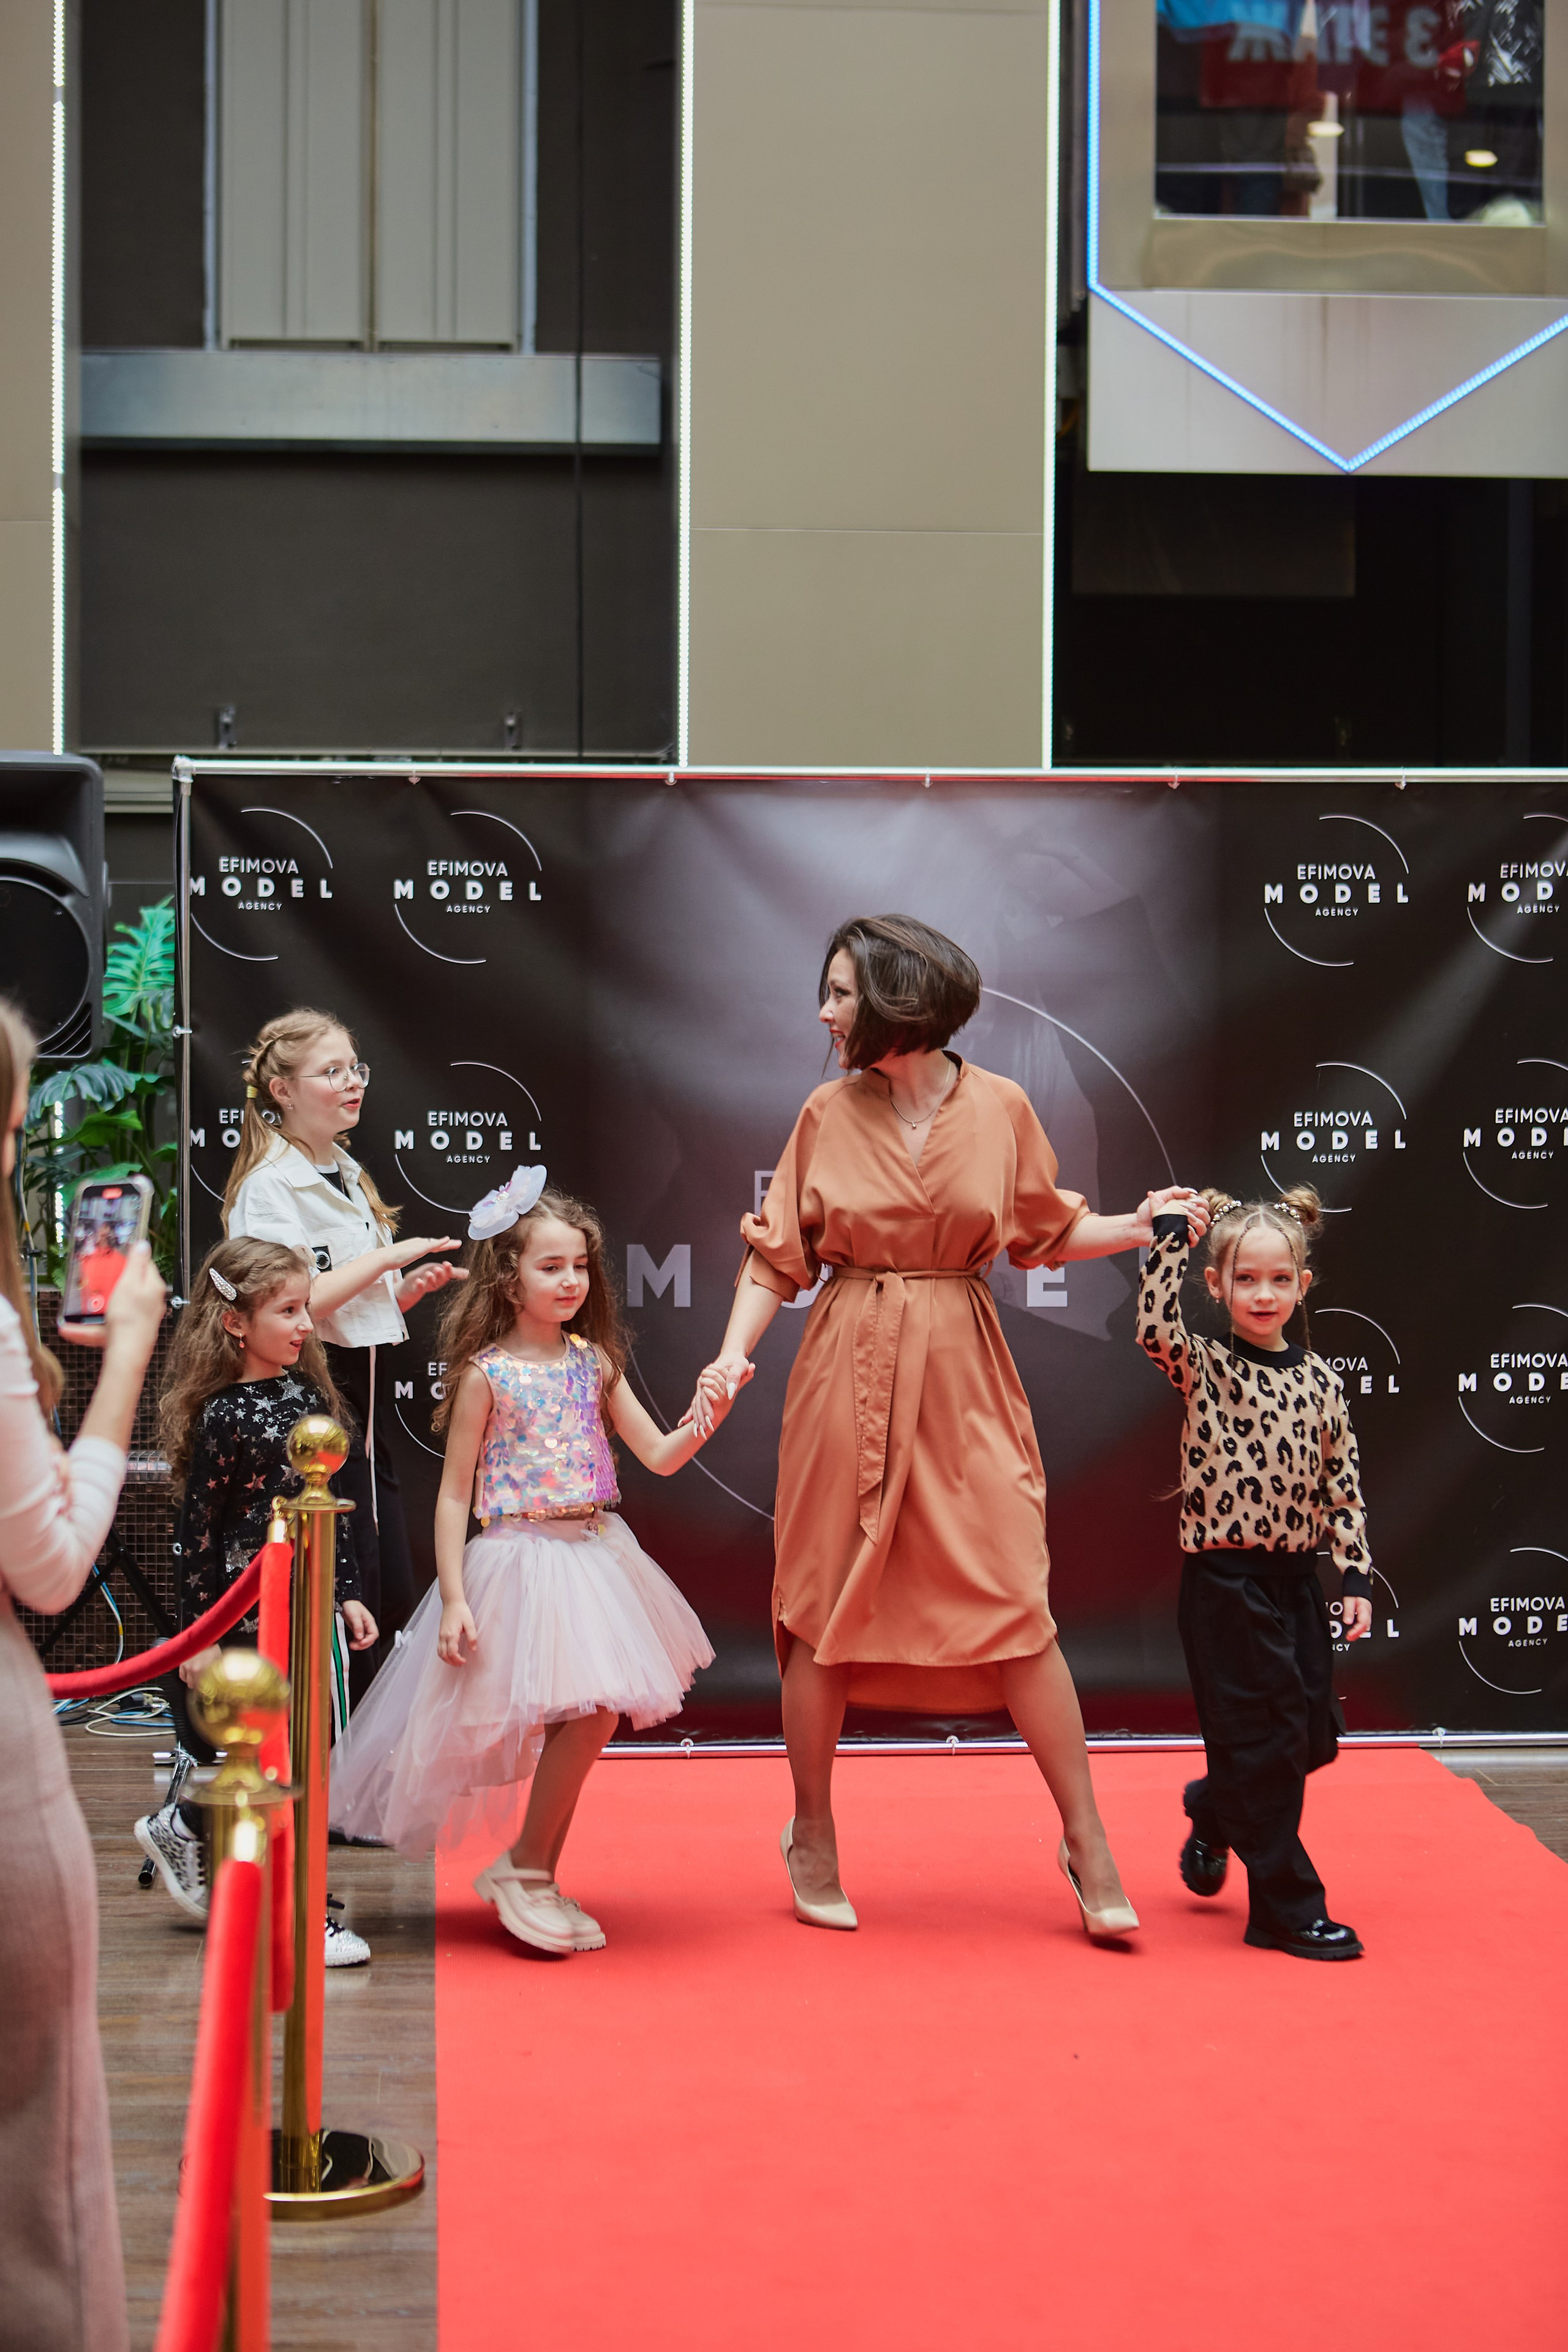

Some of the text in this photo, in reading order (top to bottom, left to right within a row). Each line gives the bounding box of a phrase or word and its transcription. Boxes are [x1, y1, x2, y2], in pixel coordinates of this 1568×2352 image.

[219, 857, 298, 873] EFIMOVA
[428, 861, 508, 876] EFIMOVA
[1298, 864, 1375, 880] EFIMOVA
[1501, 861, 1568, 878] EFIMOV
[190, 876, 332, 898] MODEL
[394, 880, 541, 900] MODEL
[1265, 883, 1408, 903] MODEL
[1468, 880, 1553, 902] MOD
[1517, 905, 1559, 914] AGENCY
[428, 1111, 507, 1126] EFIMOVA
[1294, 1111, 1373, 1126] EFIMOVA
[395, 1130, 541, 1150] MODEL
[1262, 1130, 1406, 1150] MODEL
[1491, 1353, 1567, 1368] EFIMOVA
[1459, 1373, 1568, 1392] MODE
[1491, 1597, 1564, 1611] EFIMOVA
[1459, 1614, 1568, 1635] MODE
[1509, 1638, 1547, 1647] AGENCY
